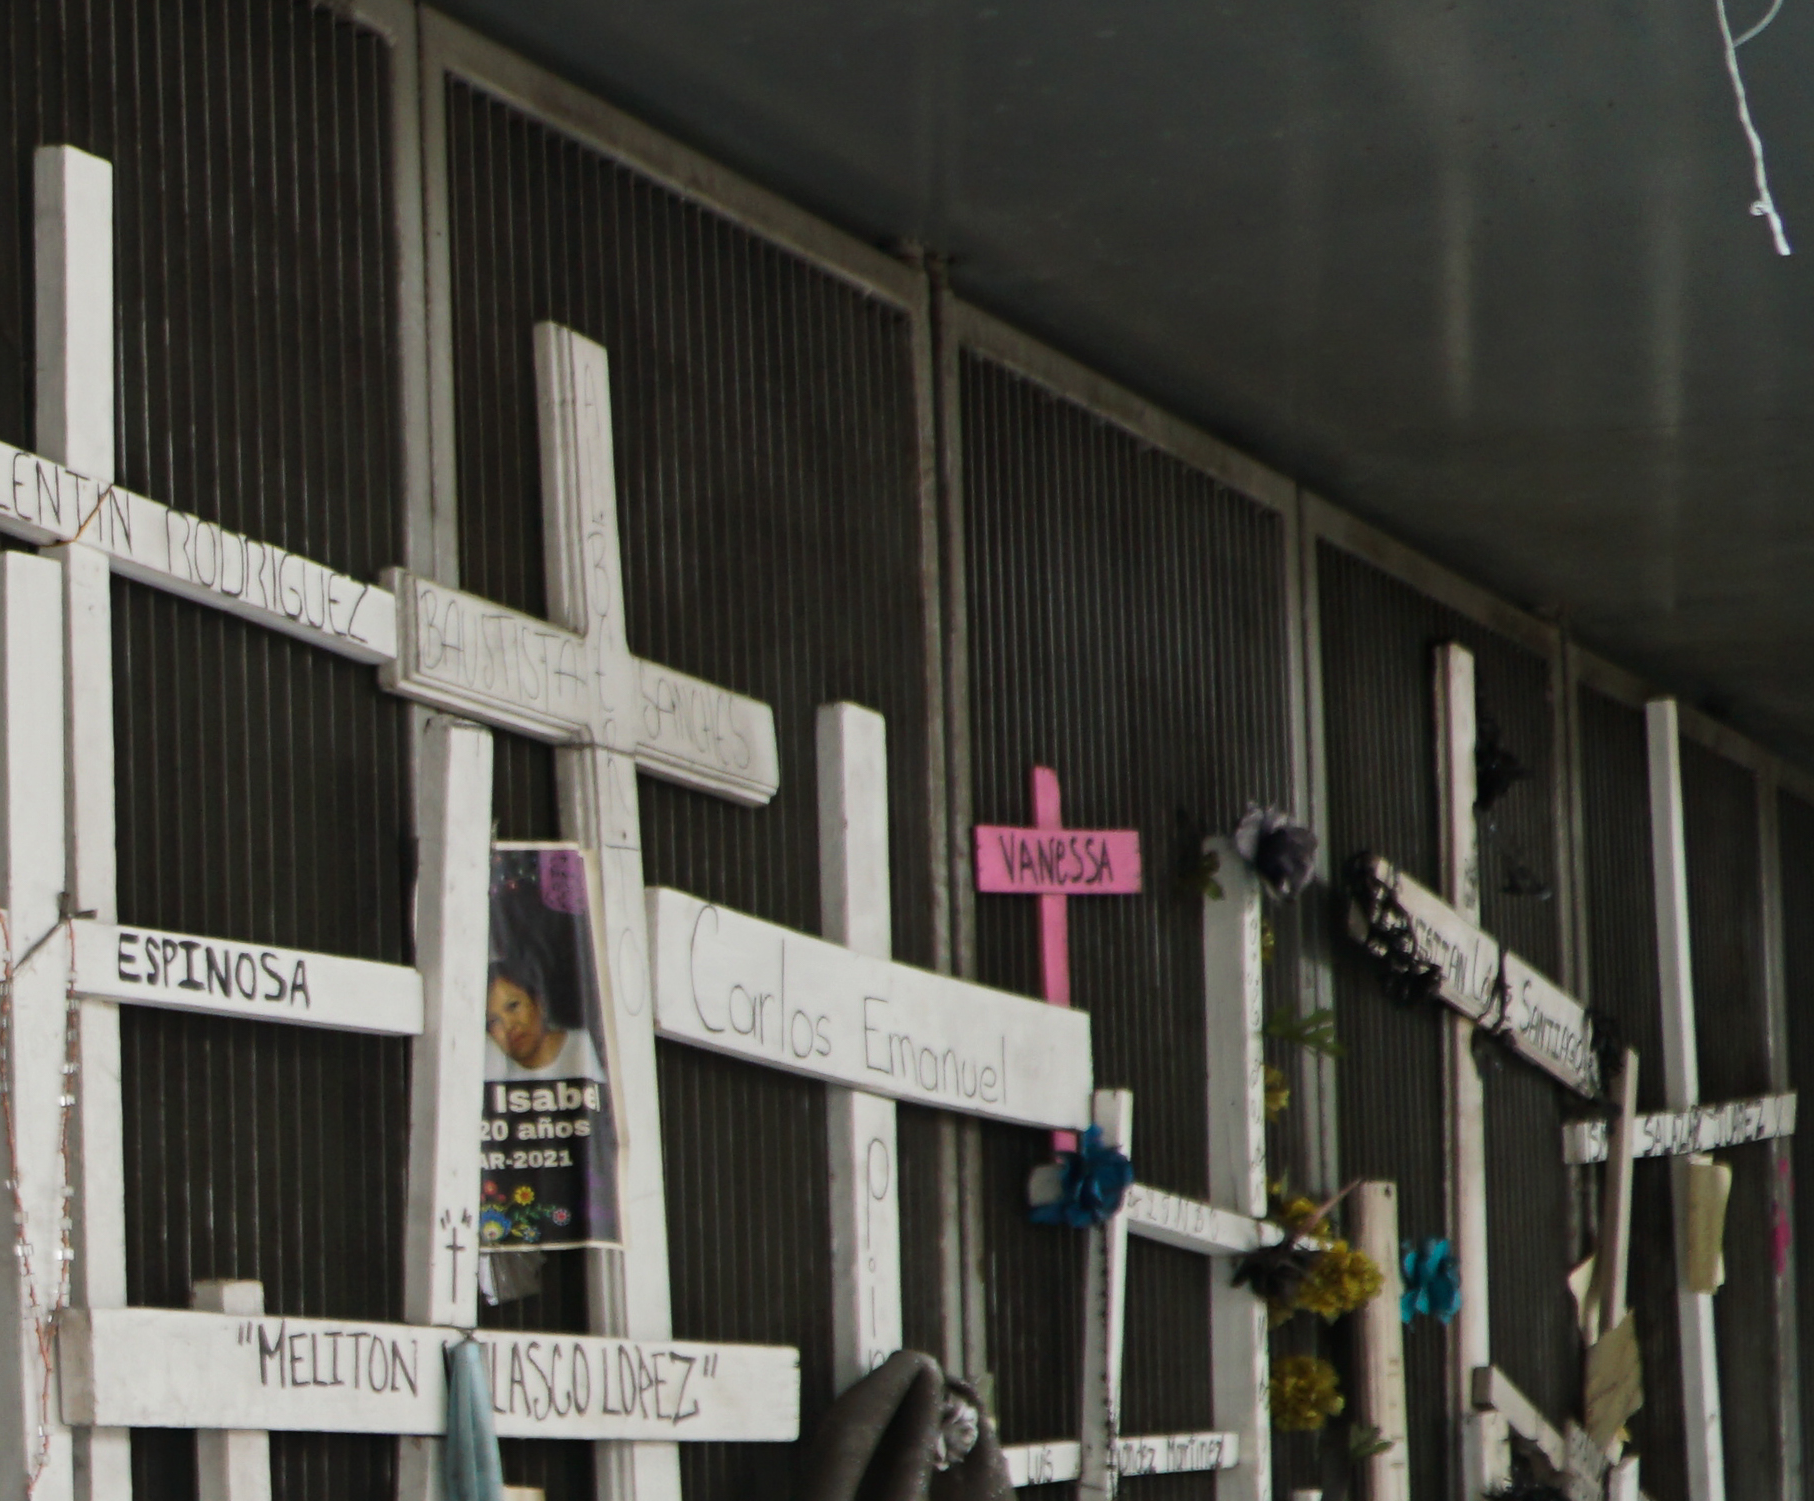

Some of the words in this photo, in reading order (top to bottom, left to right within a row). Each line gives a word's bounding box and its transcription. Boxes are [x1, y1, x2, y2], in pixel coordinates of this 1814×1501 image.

[165, 505, 371, 645] RODRIGUEZ
[116, 932, 311, 1009] ESPINOSA
[689, 903, 833, 1062] Carlos
[862, 996, 1007, 1107] Emanuel
[517, 1117, 591, 1142] años
